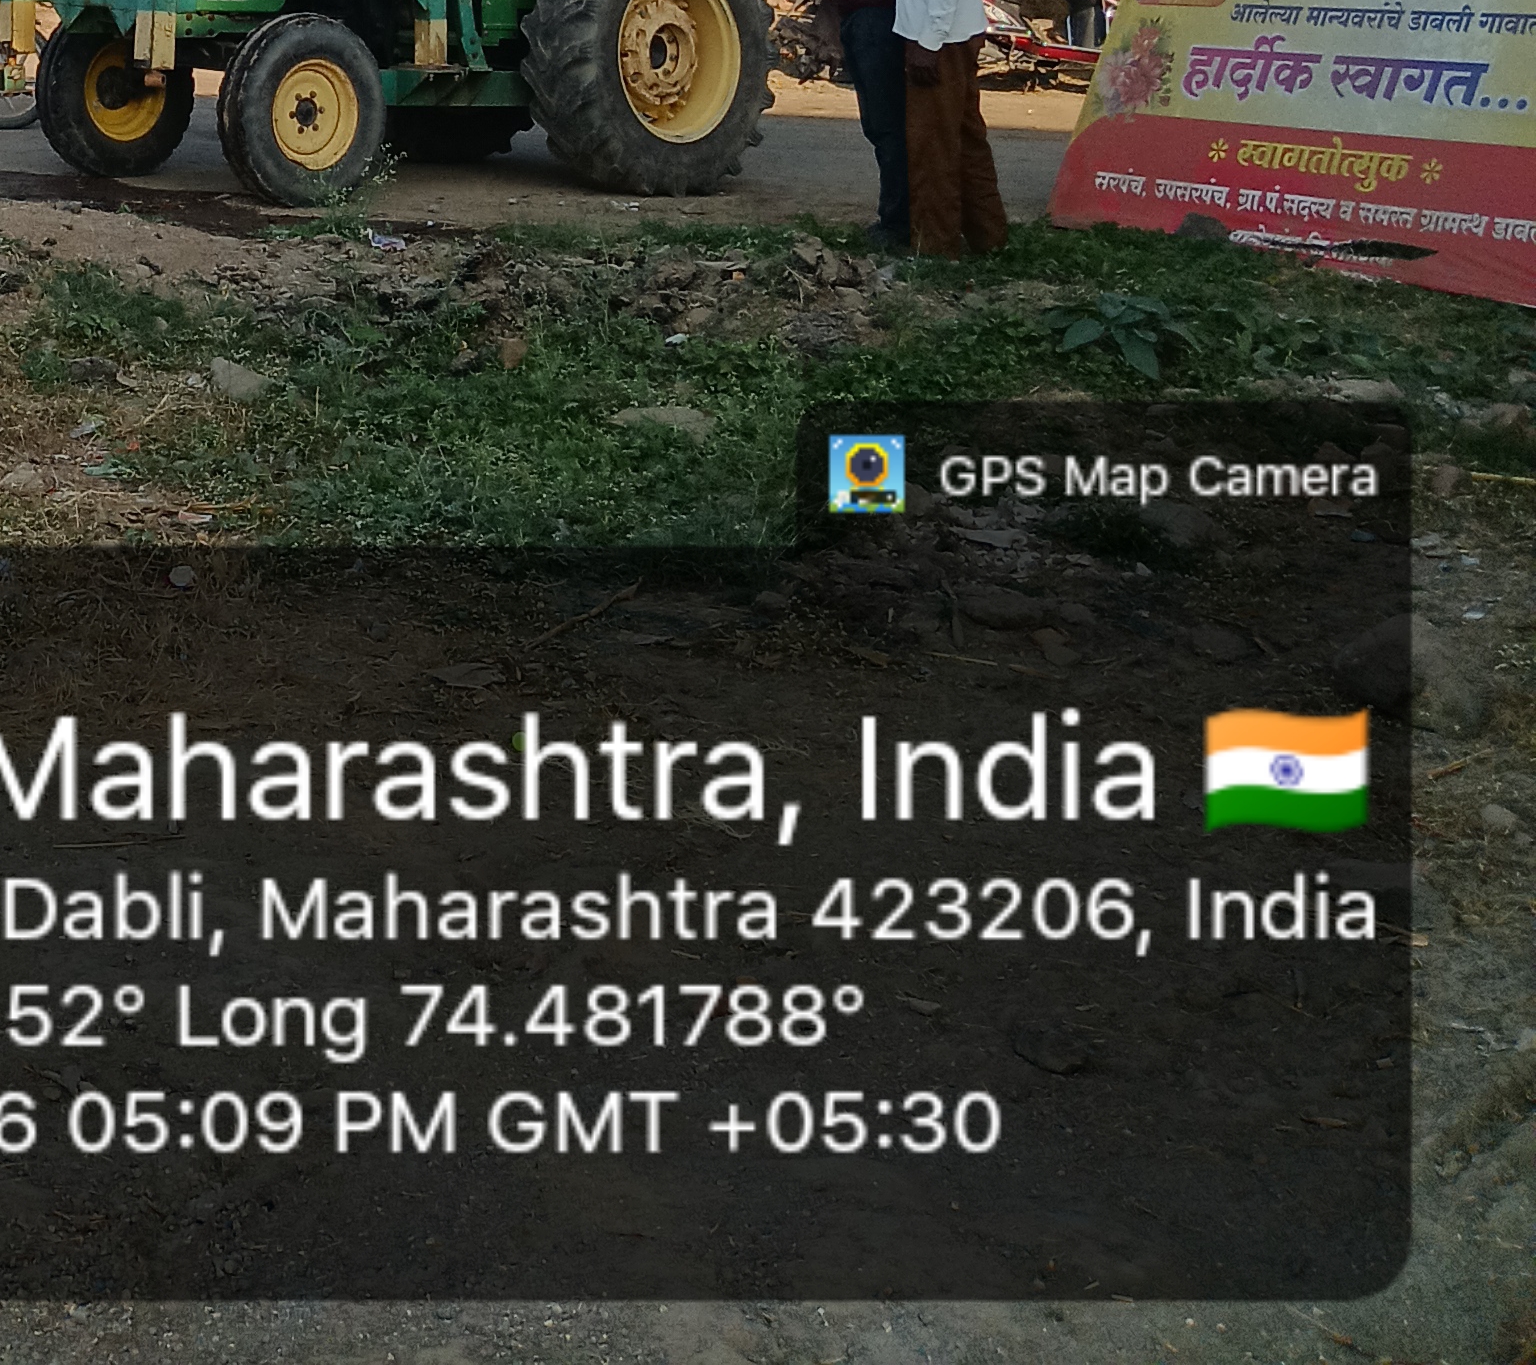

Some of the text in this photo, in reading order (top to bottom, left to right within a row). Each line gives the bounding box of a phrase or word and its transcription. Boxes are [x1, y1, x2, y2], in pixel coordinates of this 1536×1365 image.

[1306, 1, 1406, 30] मान्यवरांचे
[1408, 5, 1479, 34] डाबली
[1182, 34, 1324, 102] हार्दीक
[1236, 136, 1414, 193] स्वागतोत्सुक
[1339, 199, 1356, 222] व
[1419, 208, 1490, 237] ग्रामस्थ
